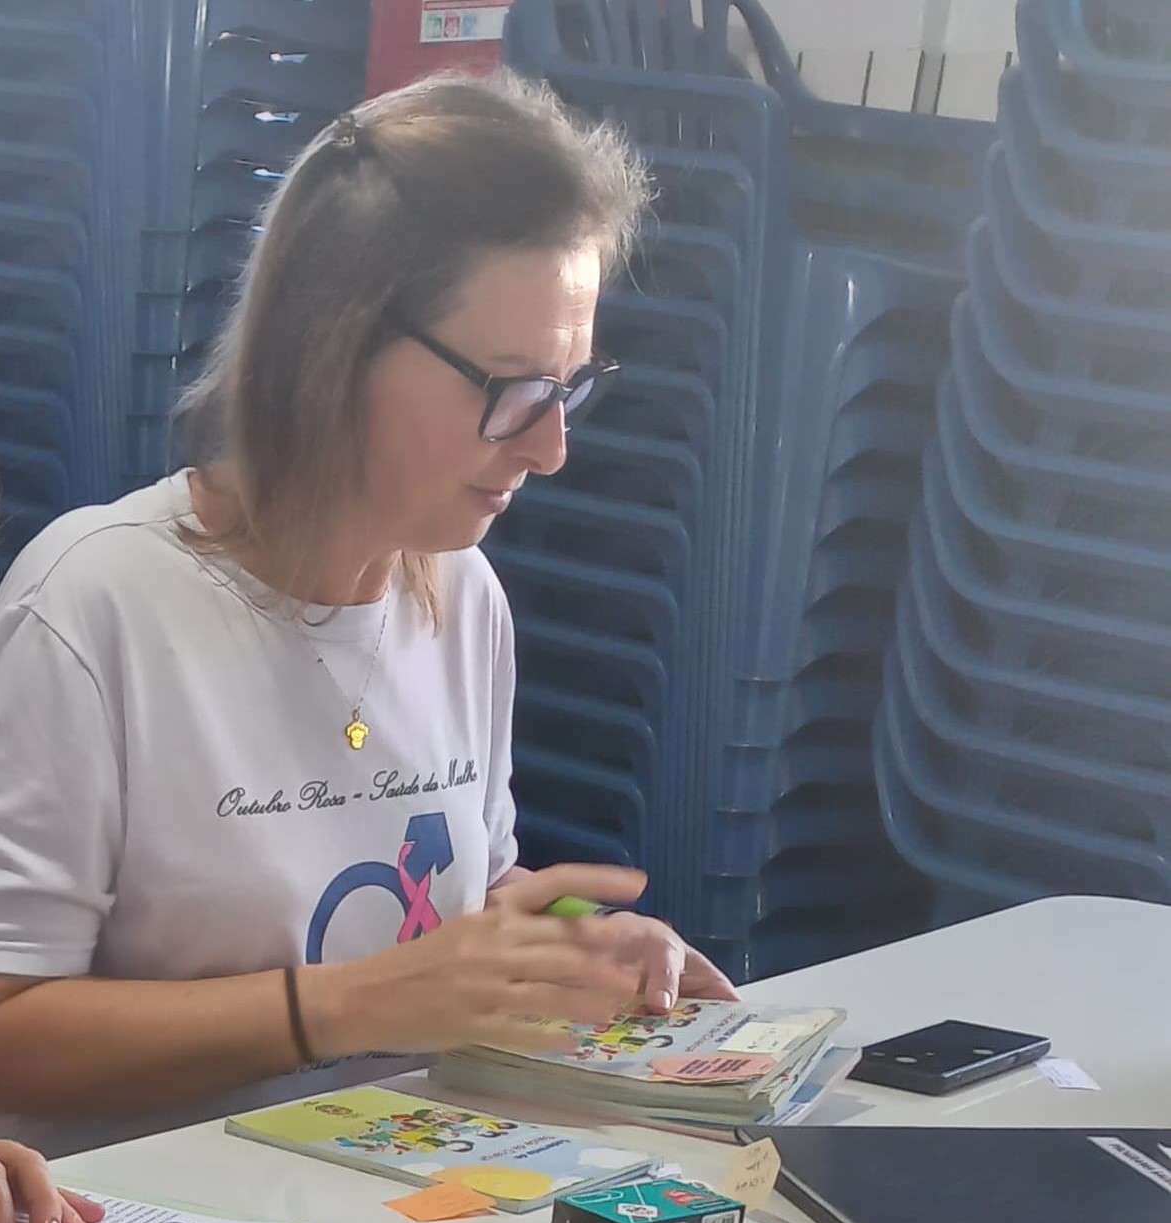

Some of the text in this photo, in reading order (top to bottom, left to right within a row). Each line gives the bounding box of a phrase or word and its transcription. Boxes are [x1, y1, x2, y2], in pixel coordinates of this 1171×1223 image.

[216, 786, 292, 818] Outubro
[297, 780, 347, 811] Rosa
[369, 770, 420, 802] Saúde
[422, 772, 439, 793] da
